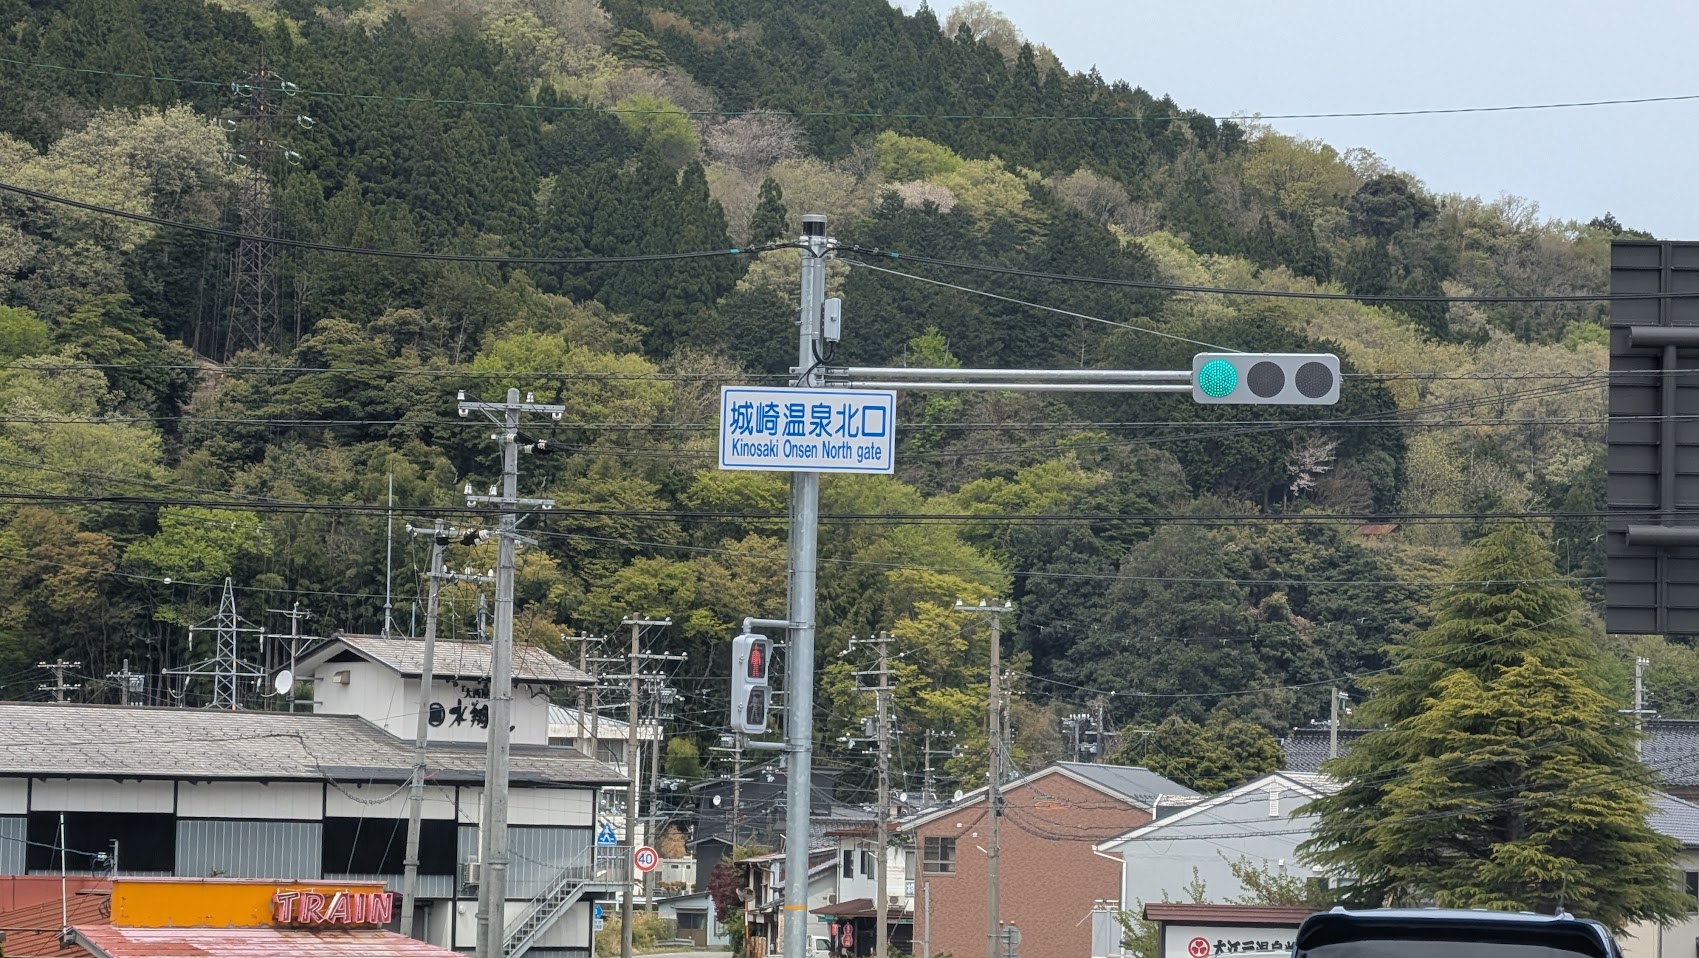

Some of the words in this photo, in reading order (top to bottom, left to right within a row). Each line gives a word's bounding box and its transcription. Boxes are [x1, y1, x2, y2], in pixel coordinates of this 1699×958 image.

[729, 401, 887, 438] 城崎温泉北口
[732, 438, 779, 458] Kinosaki
[783, 439, 818, 459] Onsen
[822, 440, 852, 460] North
[857, 442, 882, 463] gate
[638, 853, 653, 865] 40
[273, 891, 393, 924] TRAIN
